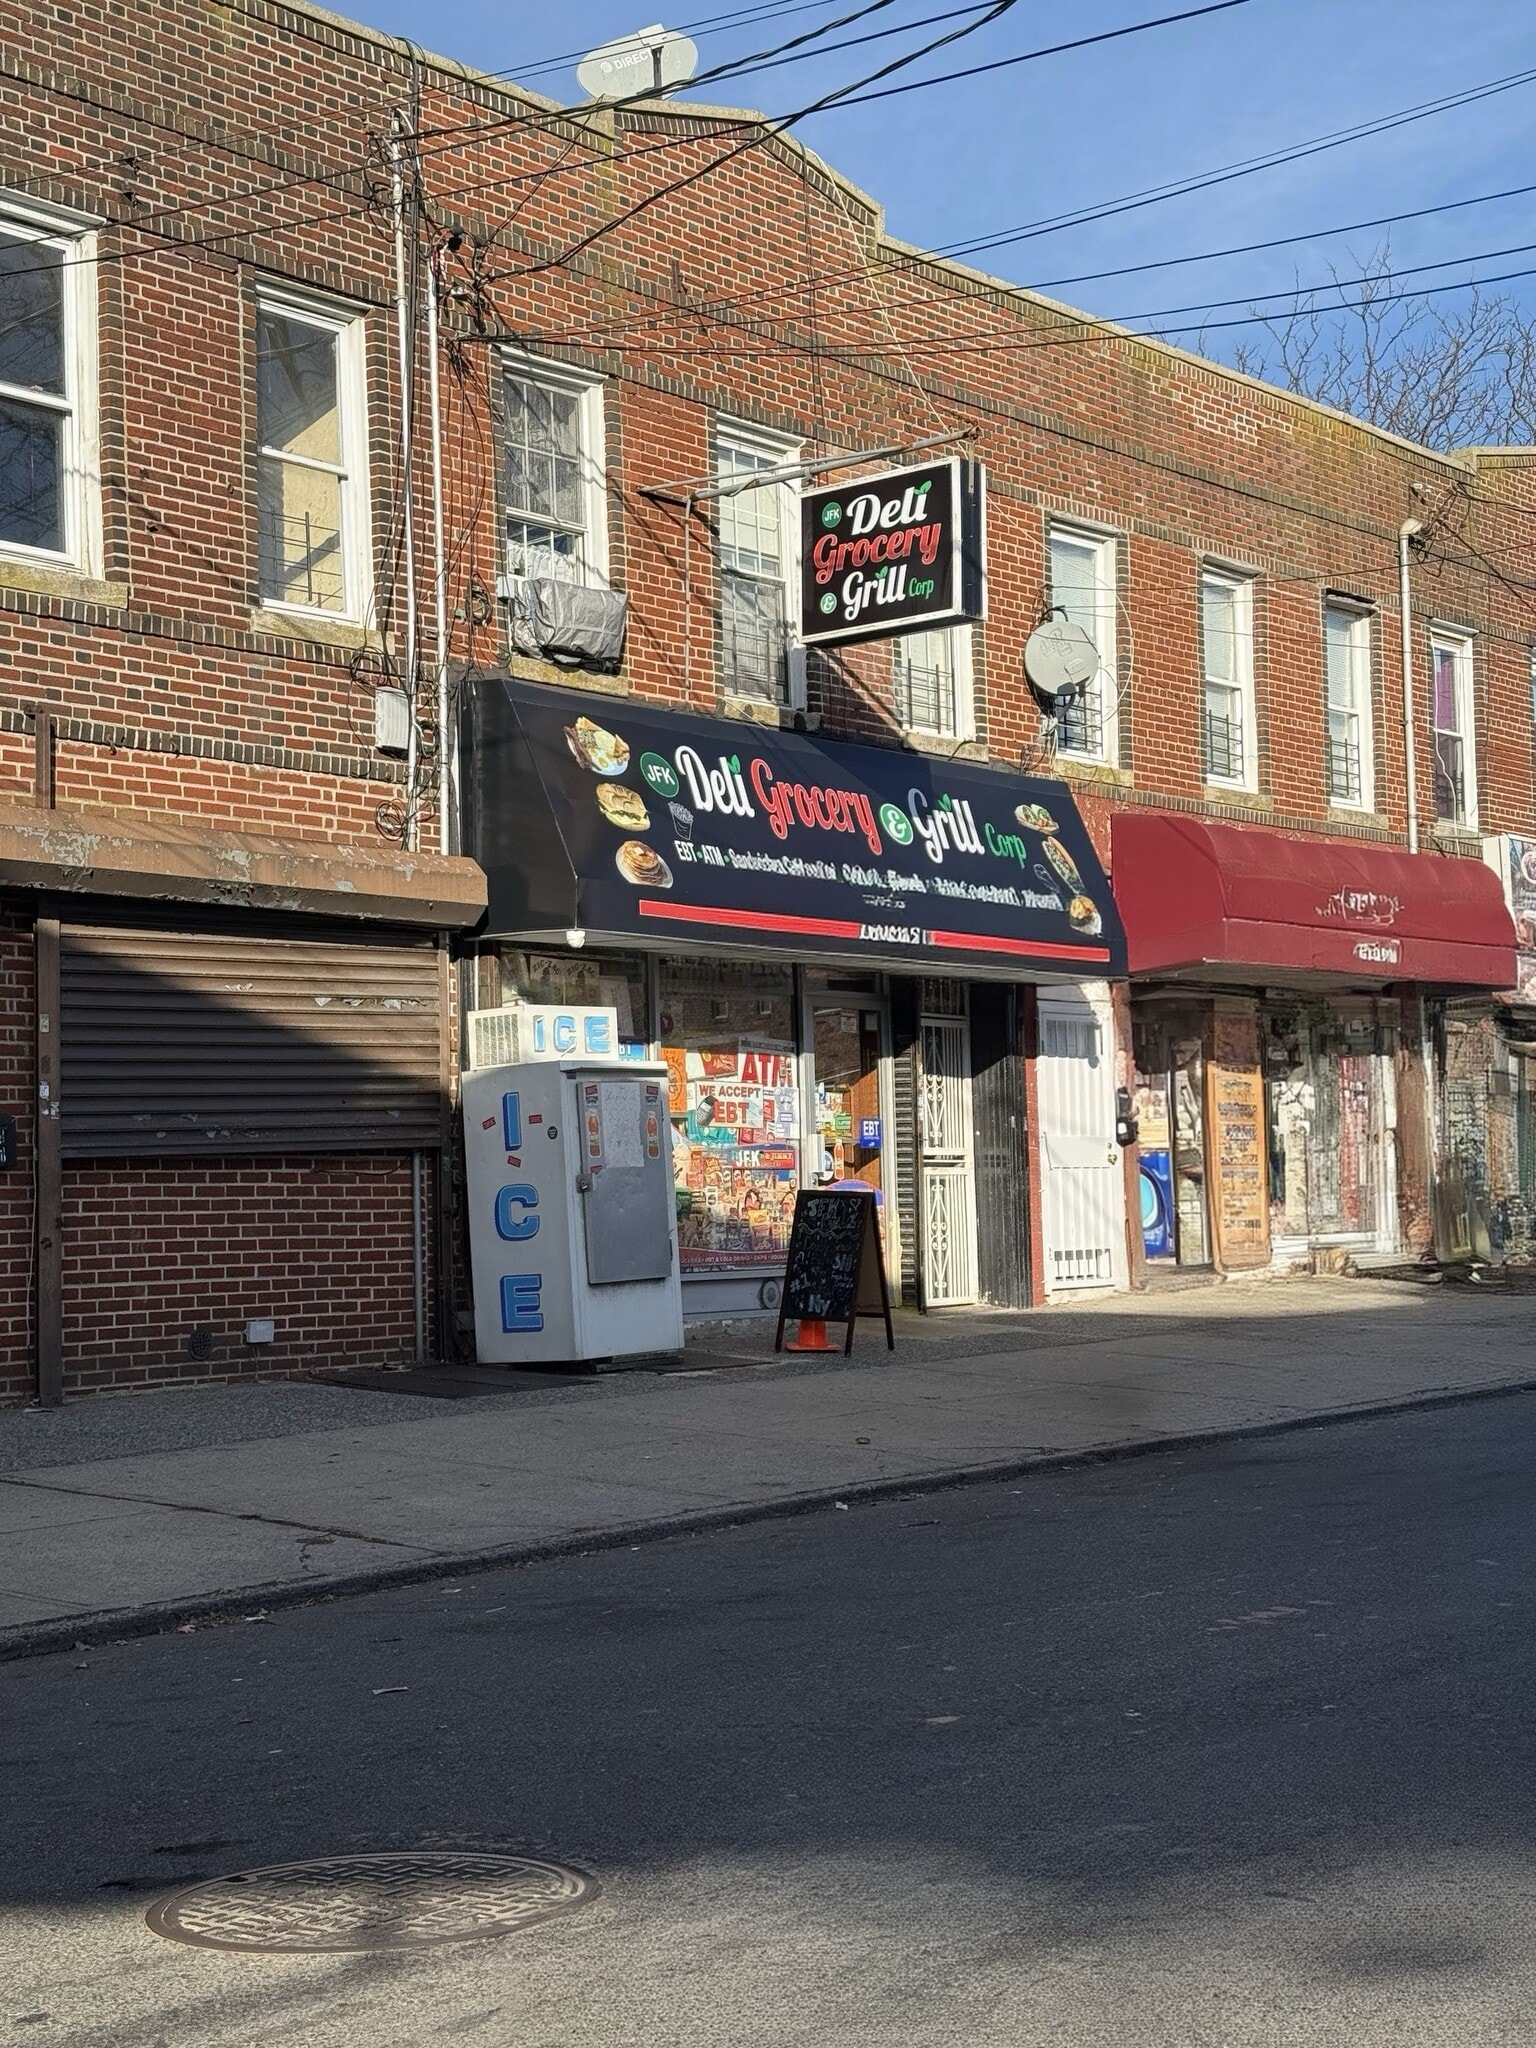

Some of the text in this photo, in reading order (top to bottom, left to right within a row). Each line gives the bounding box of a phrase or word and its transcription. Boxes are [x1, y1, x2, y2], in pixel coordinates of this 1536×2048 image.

[824, 482, 930, 535] JFK Deli
[813, 523, 942, 584] Grocery
[822, 564, 934, 620] & Grill Corp
[647, 745, 1027, 869] JFK Deli Grocery & Grill Corp
[674, 840, 698, 862] EBT
[701, 844, 725, 867] ATM
[533, 1015, 611, 1053] ICE
[699, 1085, 761, 1098] WE ACCEPT
[714, 1101, 749, 1123] EBT
[863, 1120, 880, 1136] EBT
[495, 1091, 544, 1334] ICE
